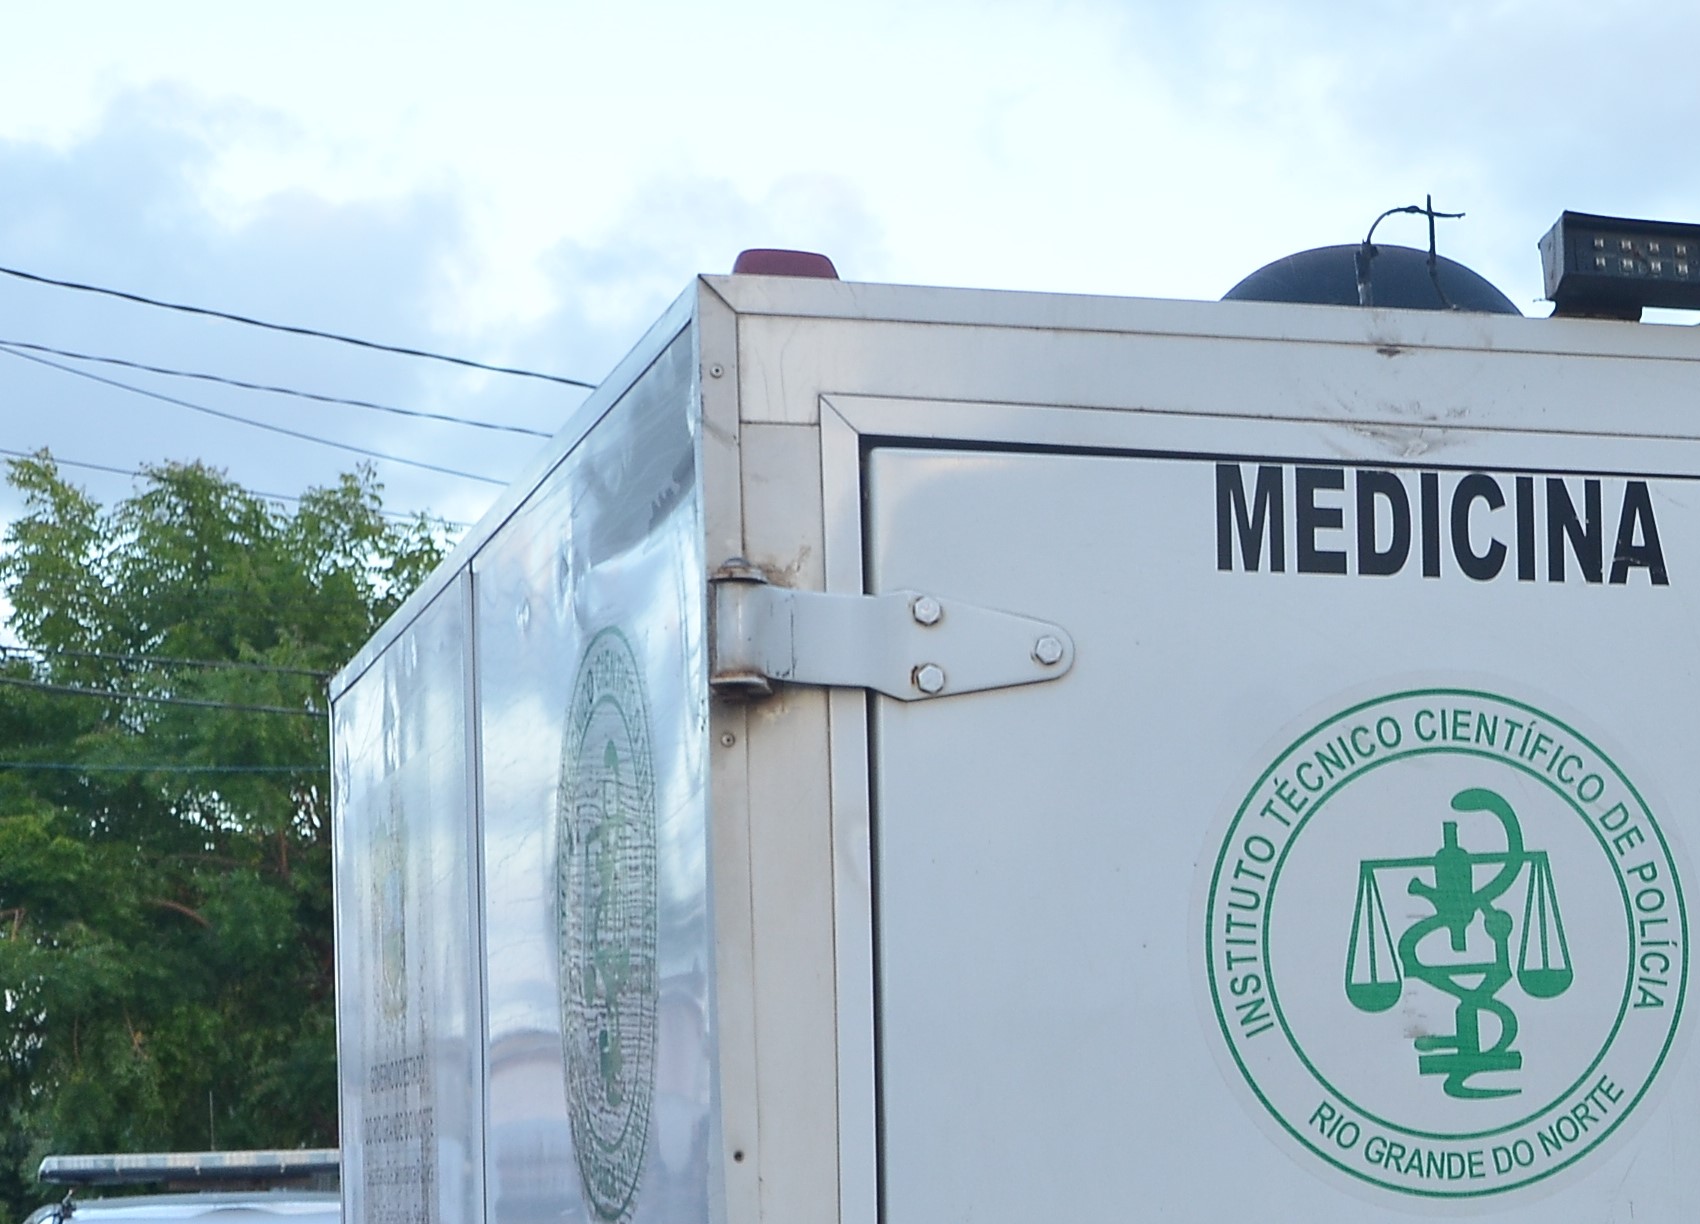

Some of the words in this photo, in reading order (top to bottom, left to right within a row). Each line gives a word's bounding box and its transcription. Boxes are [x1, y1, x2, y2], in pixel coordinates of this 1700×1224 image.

[1215, 462, 1669, 586] MEDICINA
[1226, 834, 1275, 1038] INSTITUTO
[1260, 716, 1401, 828] TÉCNICO
[1414, 709, 1604, 802] CIENTÍFICO
[1599, 802, 1645, 857] DE
[1627, 859, 1678, 1010] POLÍCIA
[1309, 1102, 1360, 1149] RIO
[1364, 1138, 1485, 1180] GRANDE
[1493, 1140, 1534, 1175] DO
[1537, 1074, 1624, 1158] NORTE
